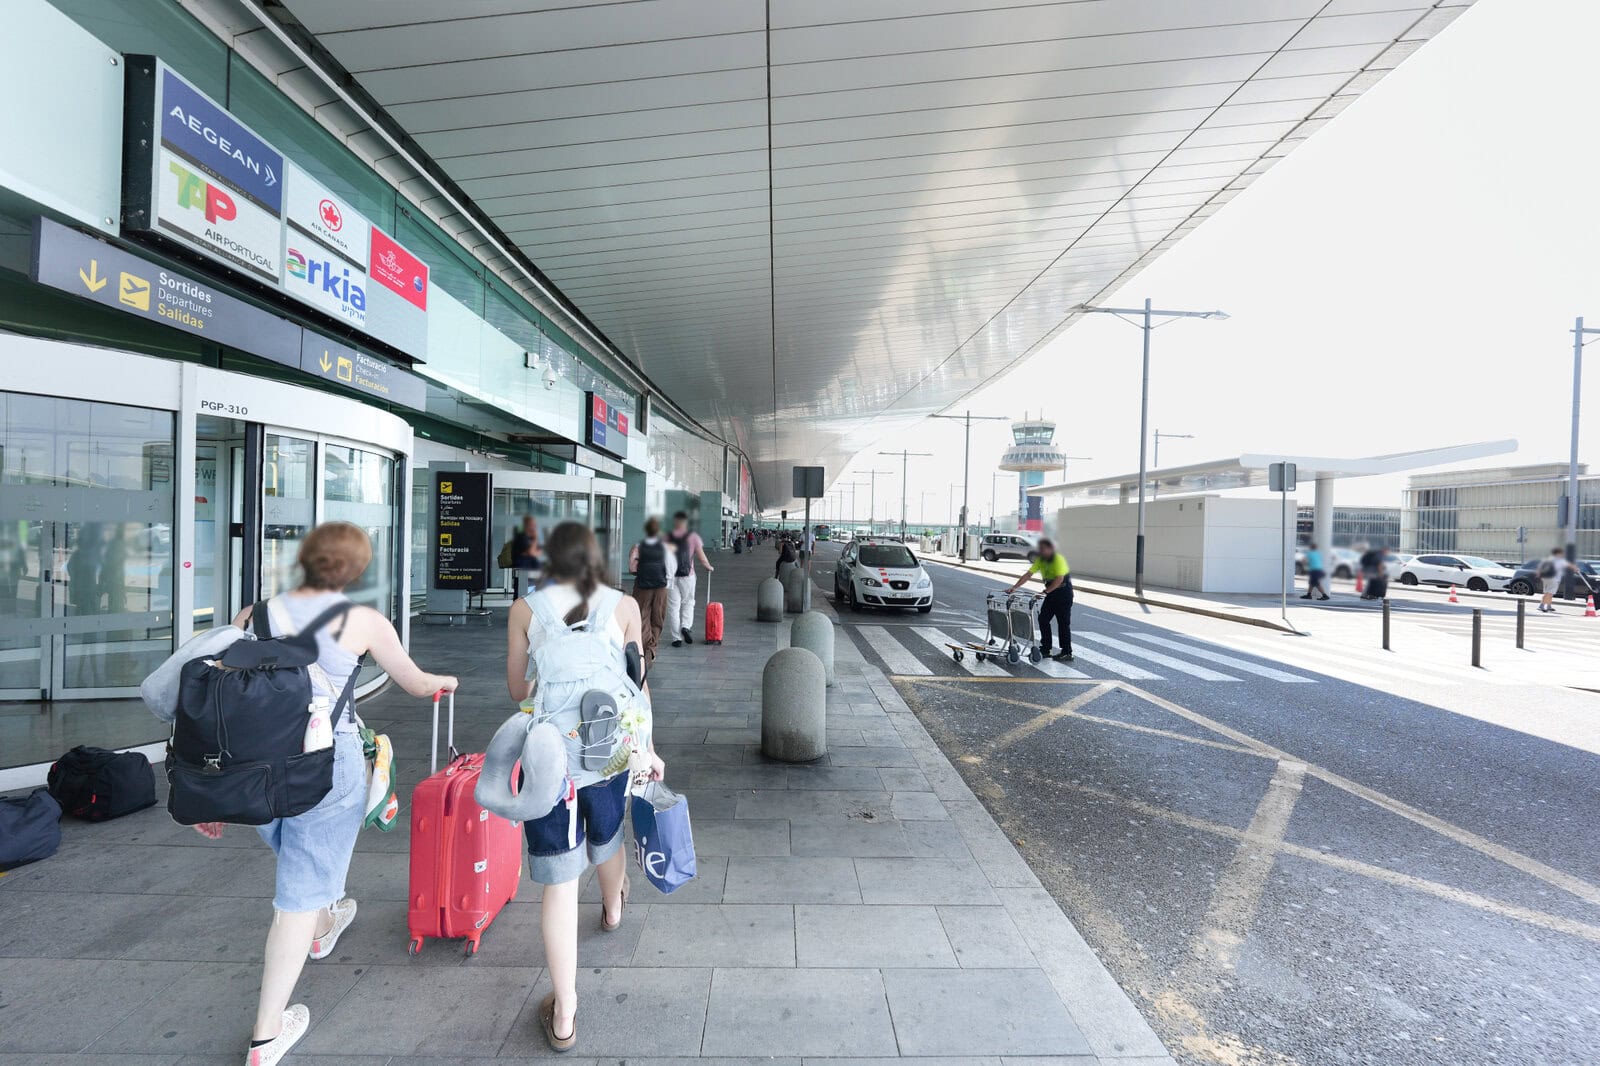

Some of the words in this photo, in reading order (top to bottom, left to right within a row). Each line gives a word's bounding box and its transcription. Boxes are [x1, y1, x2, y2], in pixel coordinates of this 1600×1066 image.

[169, 105, 260, 175] AEGEAN
[169, 160, 237, 225] TAP
[311, 222, 322, 233] AIR
[323, 230, 349, 250] CANADA
[159, 272, 212, 303] Sortides
[286, 247, 366, 312] arkia
[158, 287, 213, 318] Departures
[158, 303, 204, 329] Salidas
[356, 353, 387, 373] Facturació
[355, 374, 389, 394] Facturación
[201, 400, 248, 415] PGP-310
